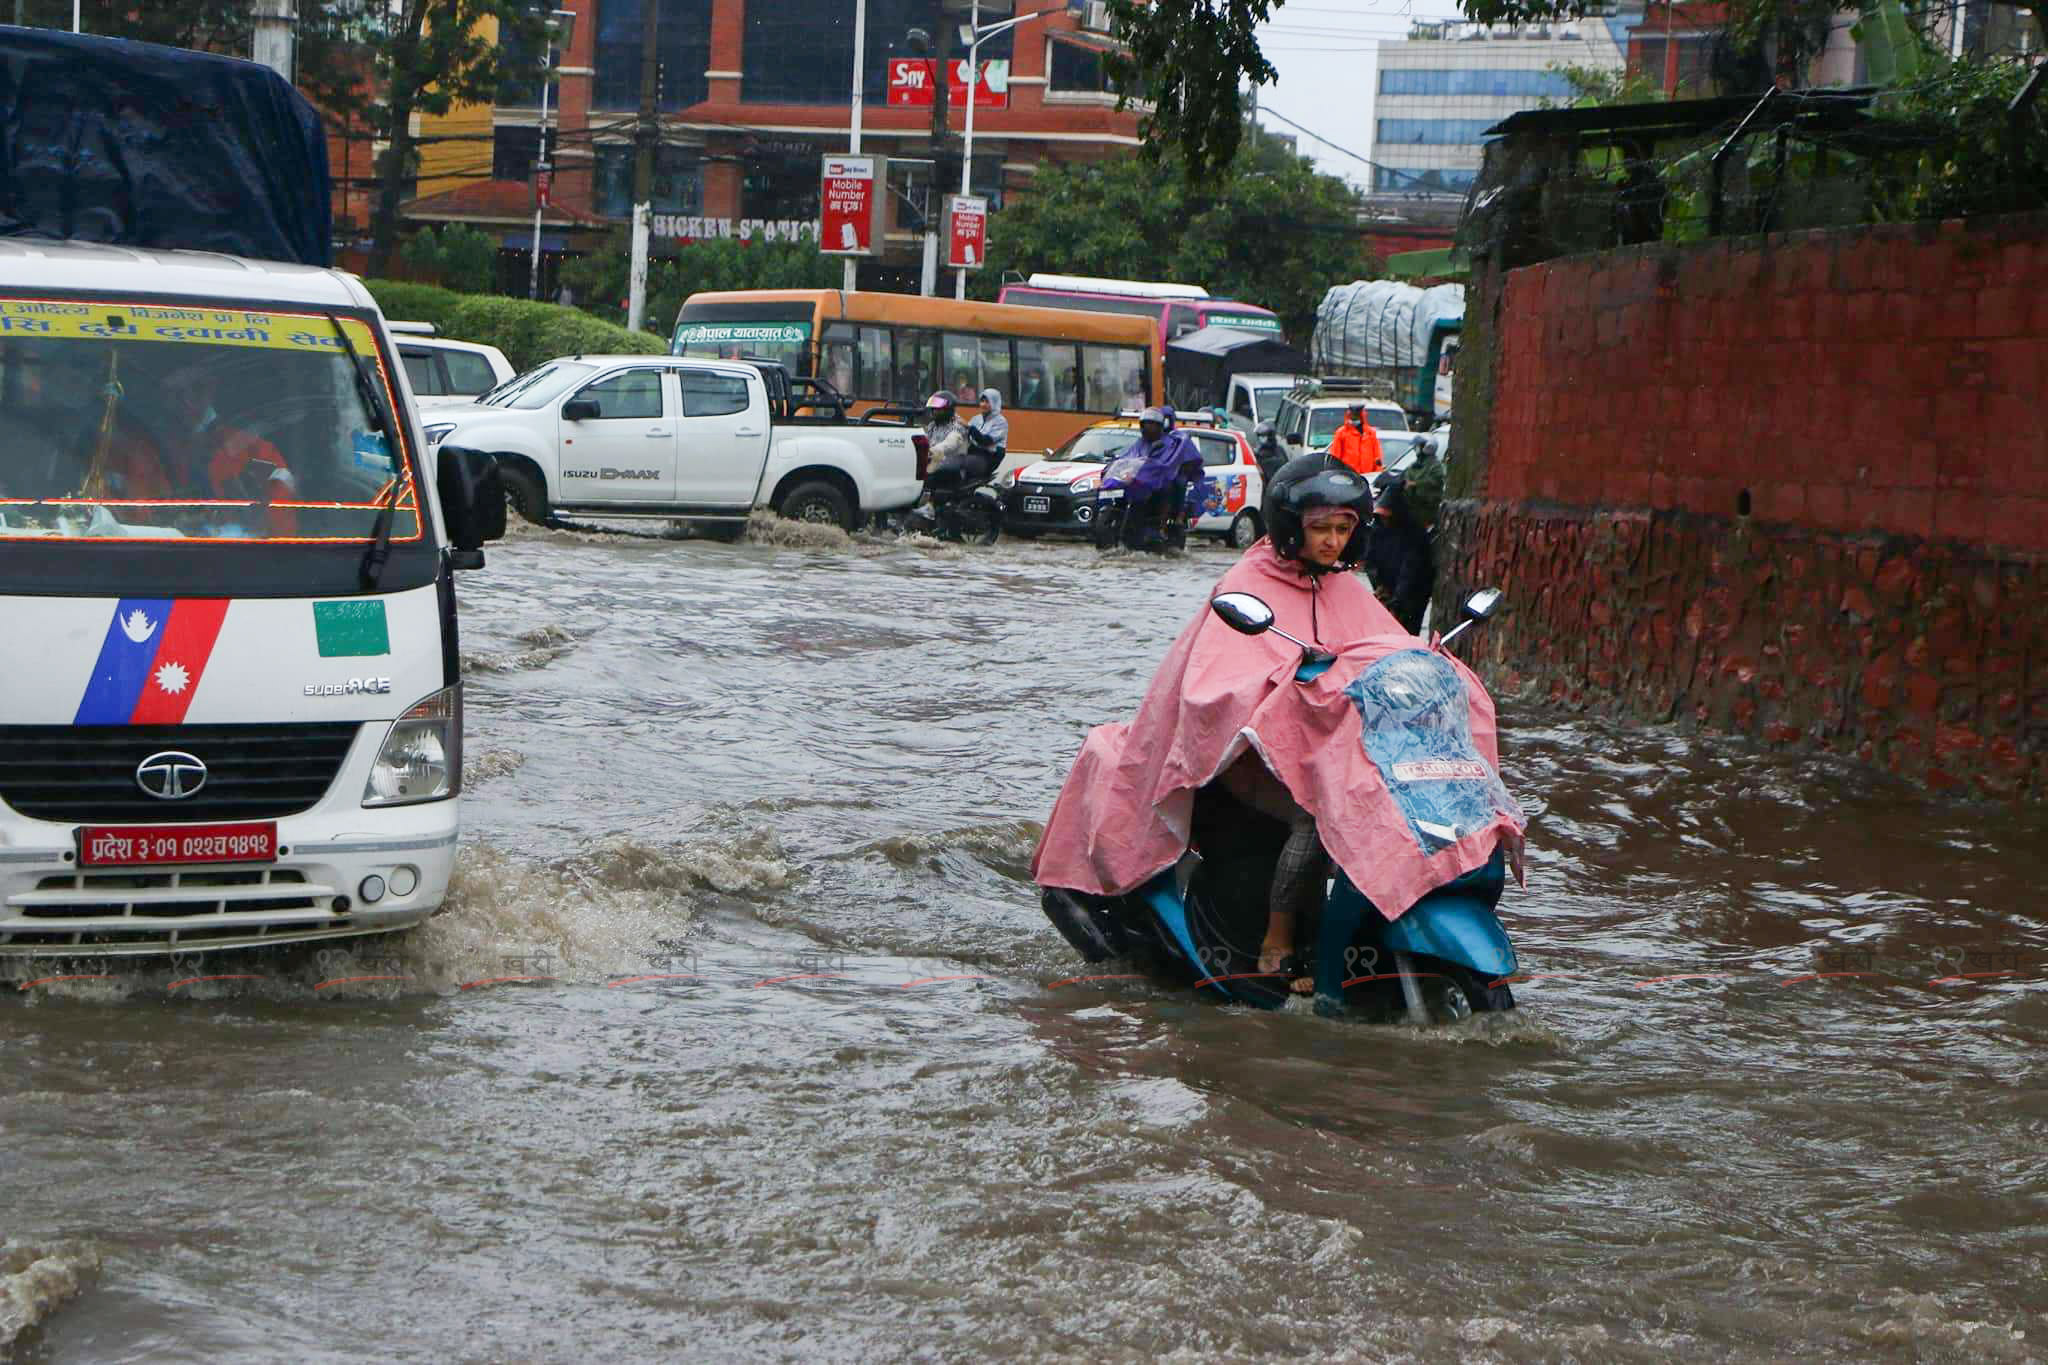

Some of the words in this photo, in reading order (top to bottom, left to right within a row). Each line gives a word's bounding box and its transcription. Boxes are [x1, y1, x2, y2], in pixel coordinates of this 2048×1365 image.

[832, 179, 863, 190] Mobile
[828, 189, 865, 200] Number
[653, 215, 732, 239] HICKEN
[696, 326, 732, 339] नेपाल
[733, 326, 784, 339] यातायात
[563, 469, 598, 478] ISUZU
[92, 832, 133, 861] प्रदेश
